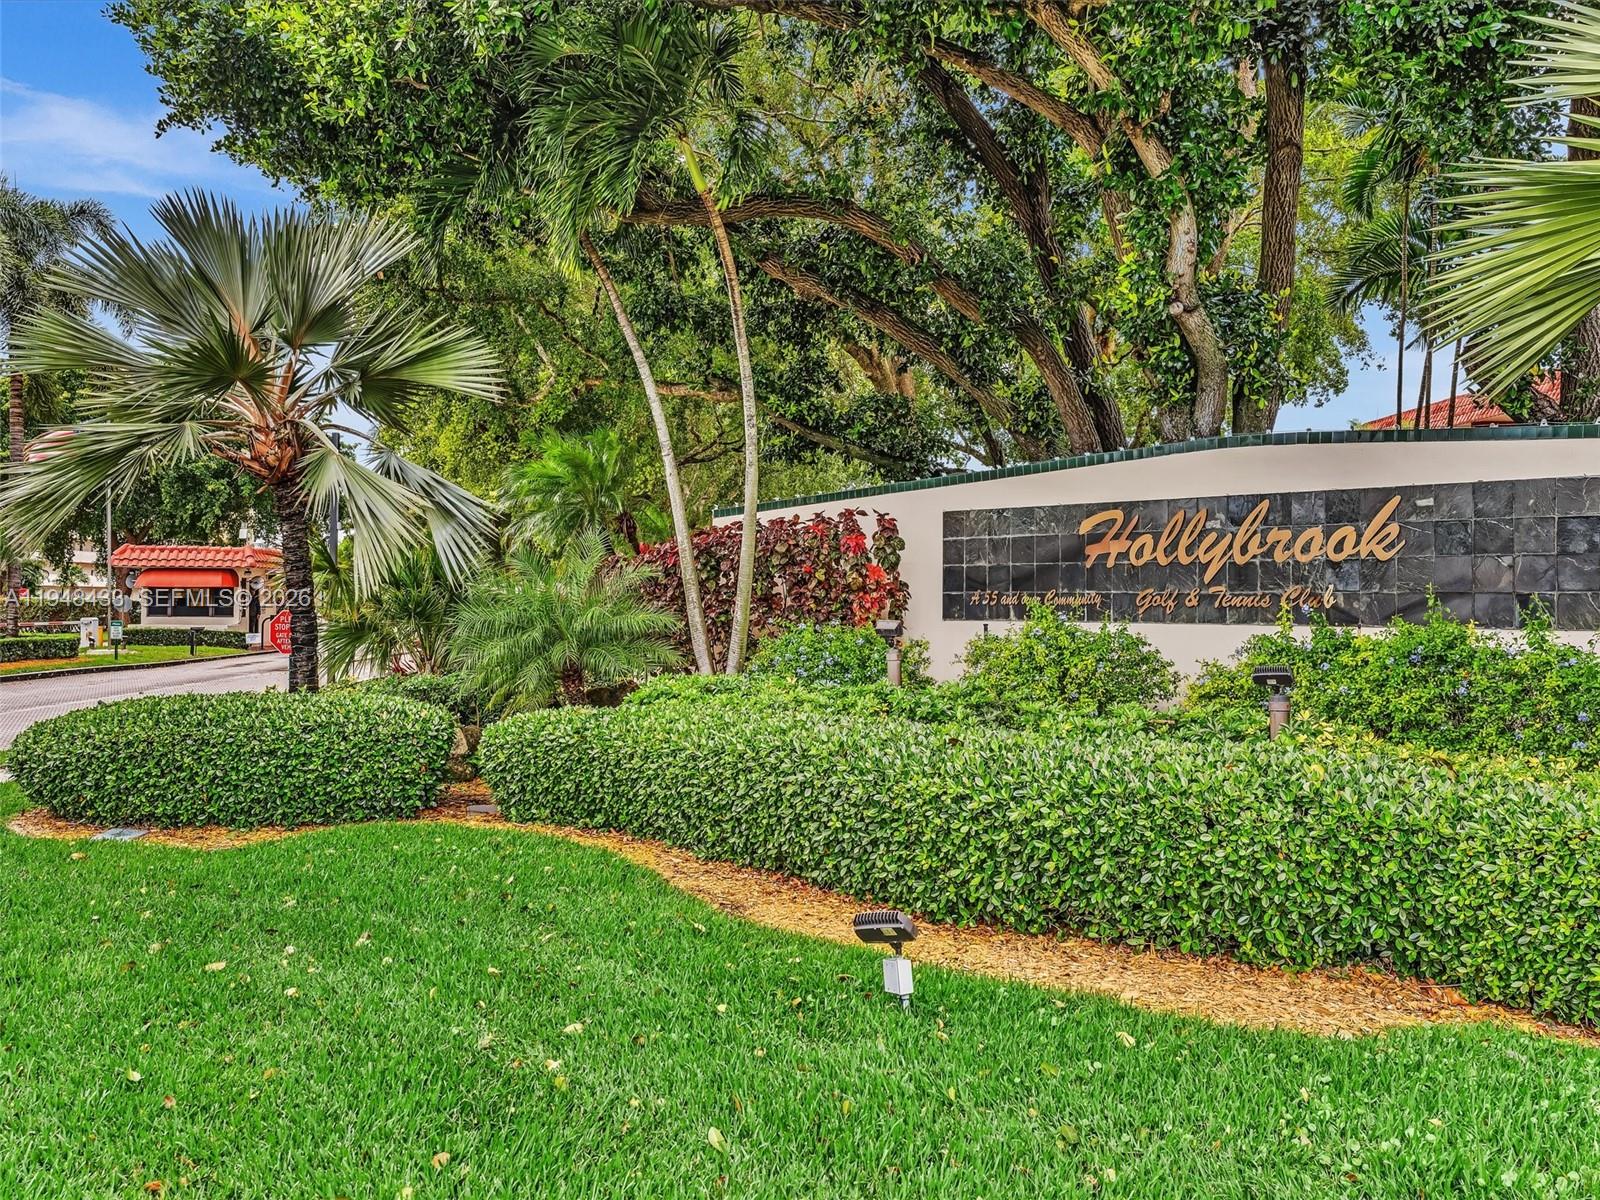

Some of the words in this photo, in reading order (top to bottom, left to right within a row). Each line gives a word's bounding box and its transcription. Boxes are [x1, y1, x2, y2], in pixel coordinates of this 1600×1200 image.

[1079, 495, 1406, 584] Hollybrook
[970, 590, 981, 605] A
[982, 590, 999, 605] 55
[1001, 590, 1020, 605] and
[1044, 589, 1104, 609] Community
[1136, 588, 1178, 614] Golf
[1185, 588, 1200, 608] &
[1209, 585, 1273, 608] Tennis
[1281, 584, 1337, 608] Club
